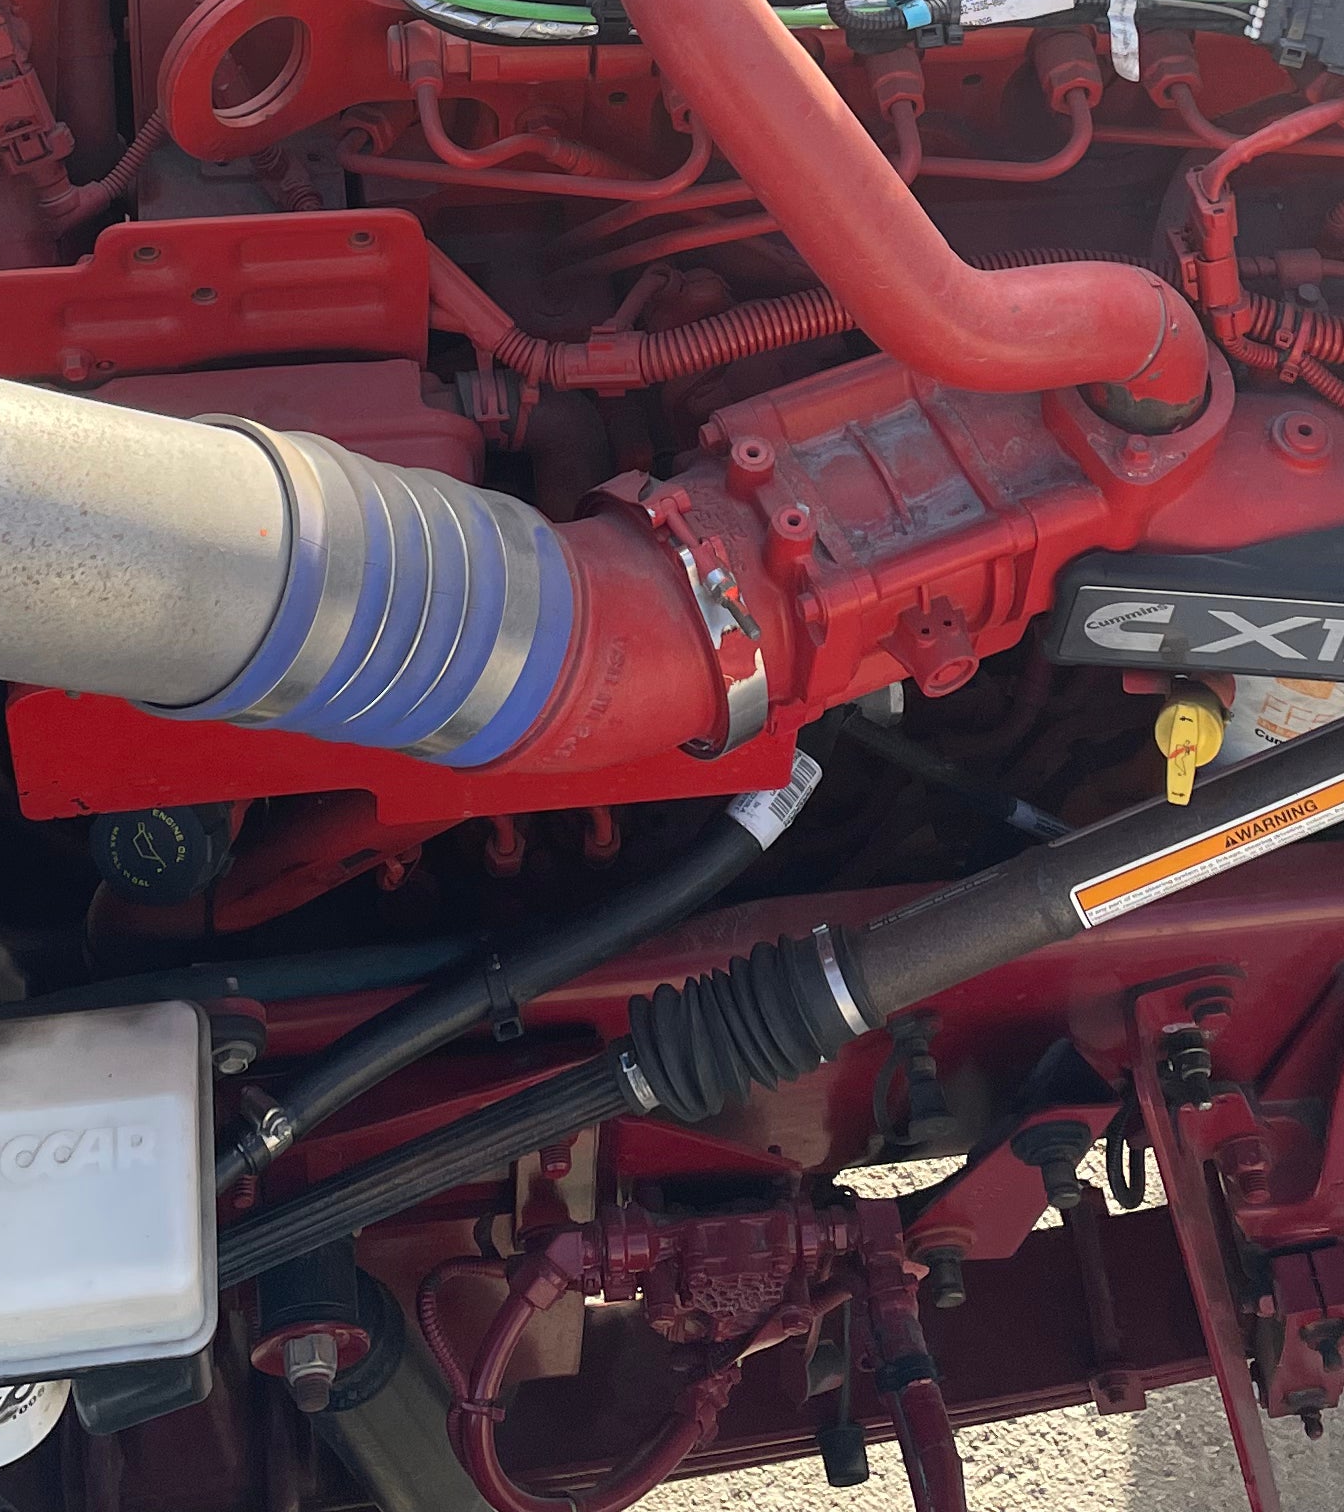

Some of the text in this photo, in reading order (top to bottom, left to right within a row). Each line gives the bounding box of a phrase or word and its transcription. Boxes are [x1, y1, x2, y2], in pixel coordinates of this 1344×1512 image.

[1086, 603, 1170, 630] Cummins
[152, 808, 186, 863] ENGINE OIL
[1234, 798, 1319, 842] WARNING
